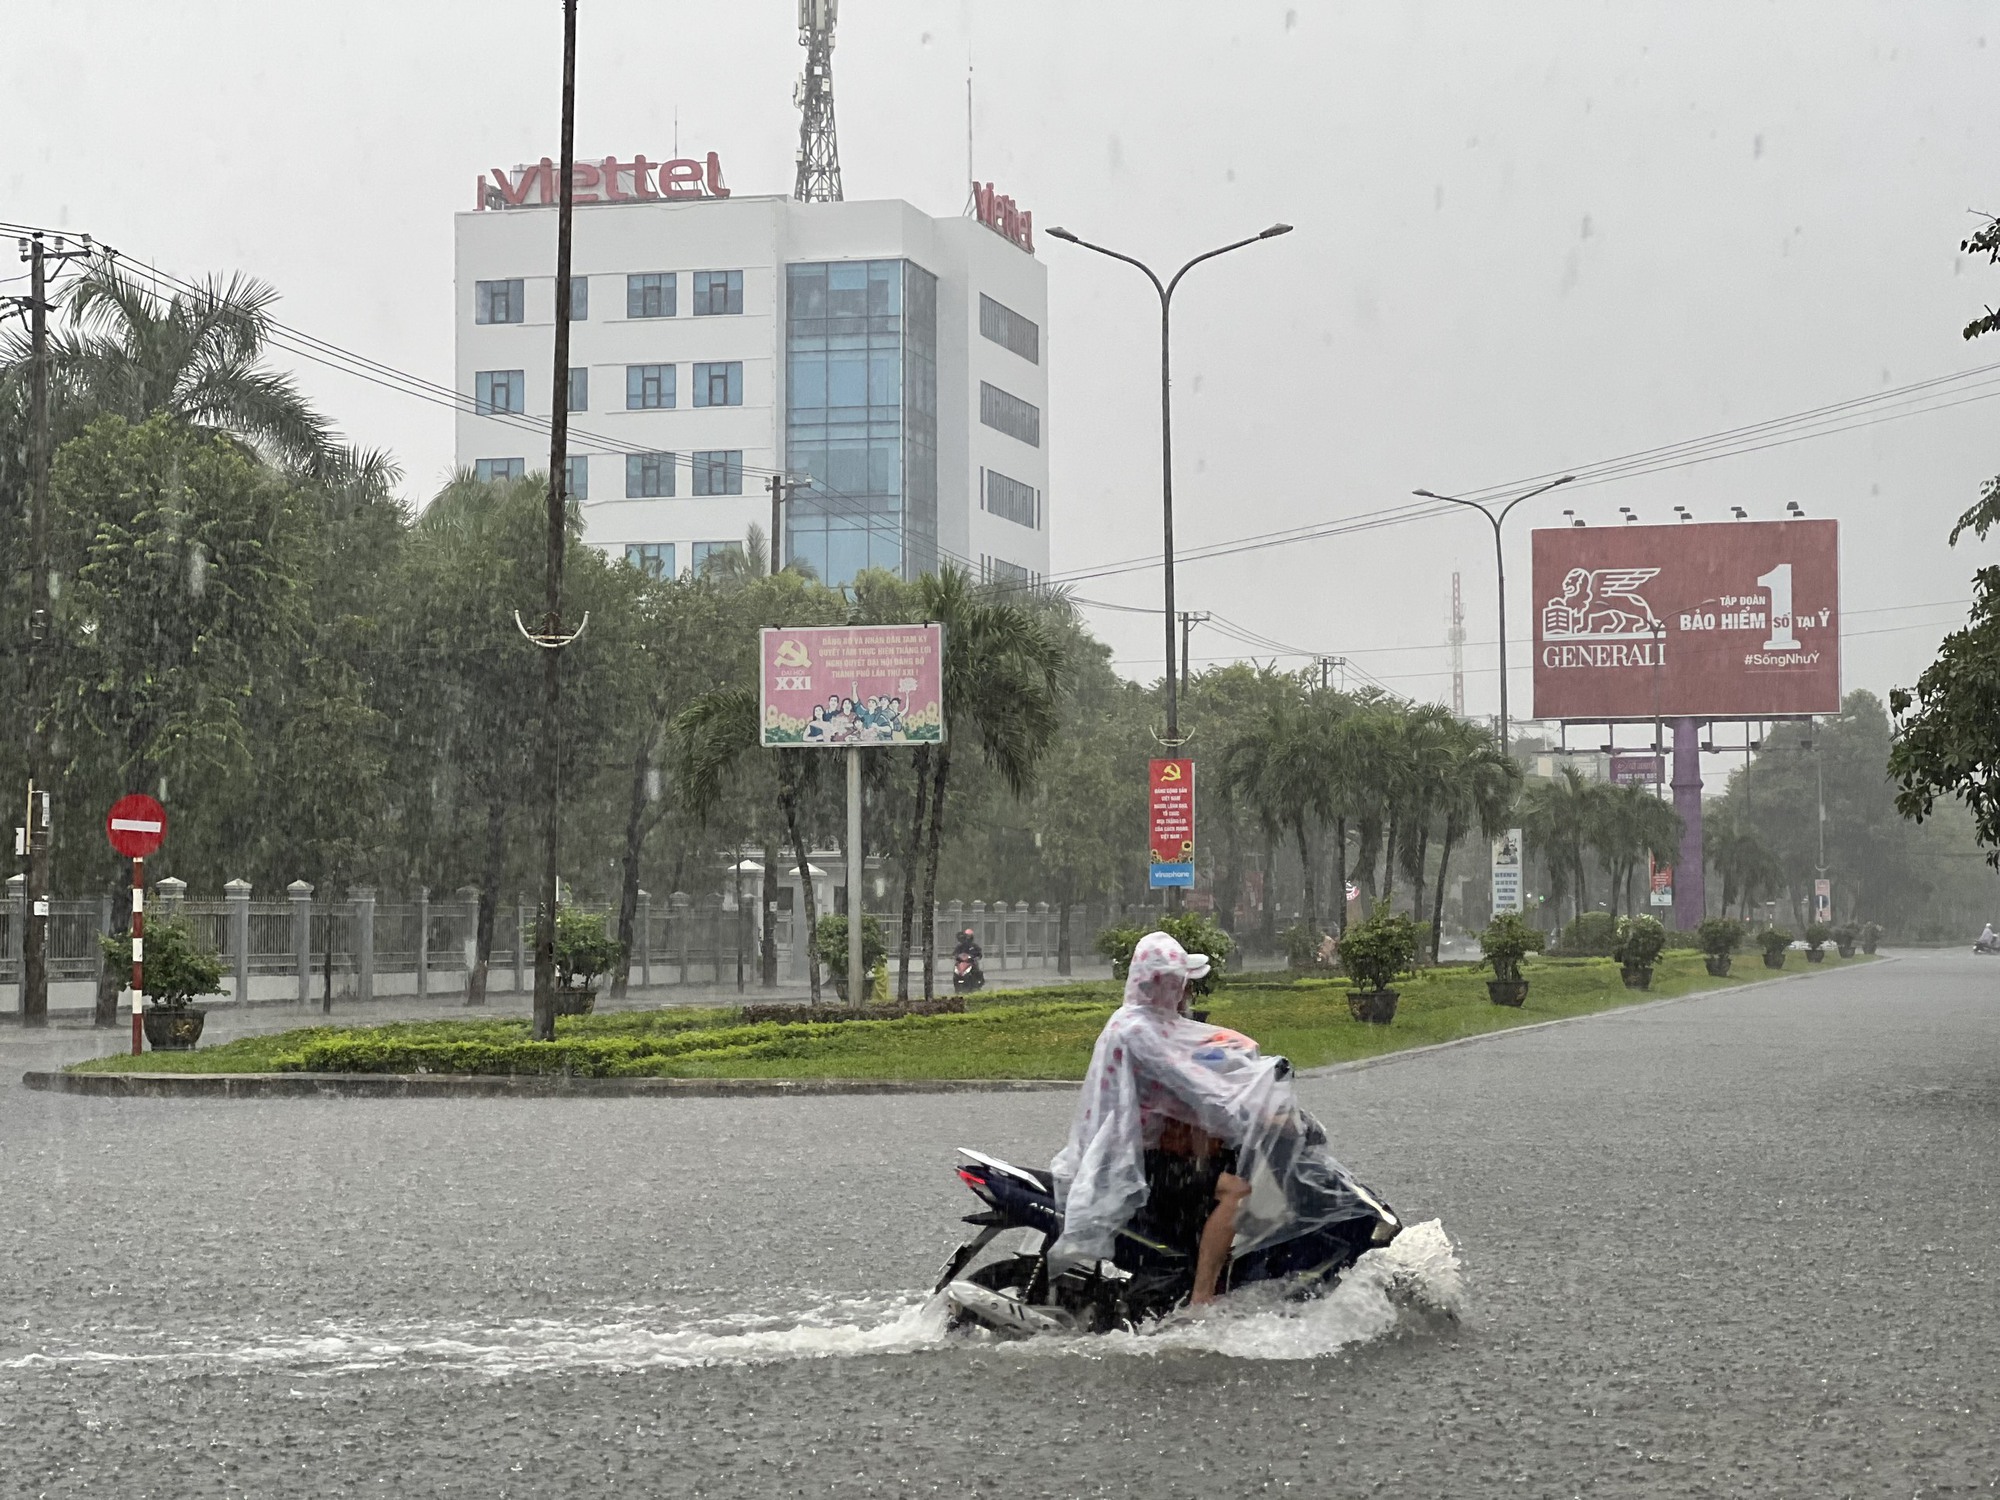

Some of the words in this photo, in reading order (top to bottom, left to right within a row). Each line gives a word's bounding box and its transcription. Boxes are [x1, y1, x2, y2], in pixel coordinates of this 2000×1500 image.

[491, 152, 730, 204] viettel
[1720, 596, 1737, 606] TẬP
[1740, 594, 1765, 605] ĐOÀN
[1680, 610, 1715, 630] BẢO
[1721, 607, 1765, 629] HIỂM
[1797, 616, 1815, 628] TẠI
[1543, 643, 1666, 668] GENERALI
[774, 677, 812, 690] XXI
